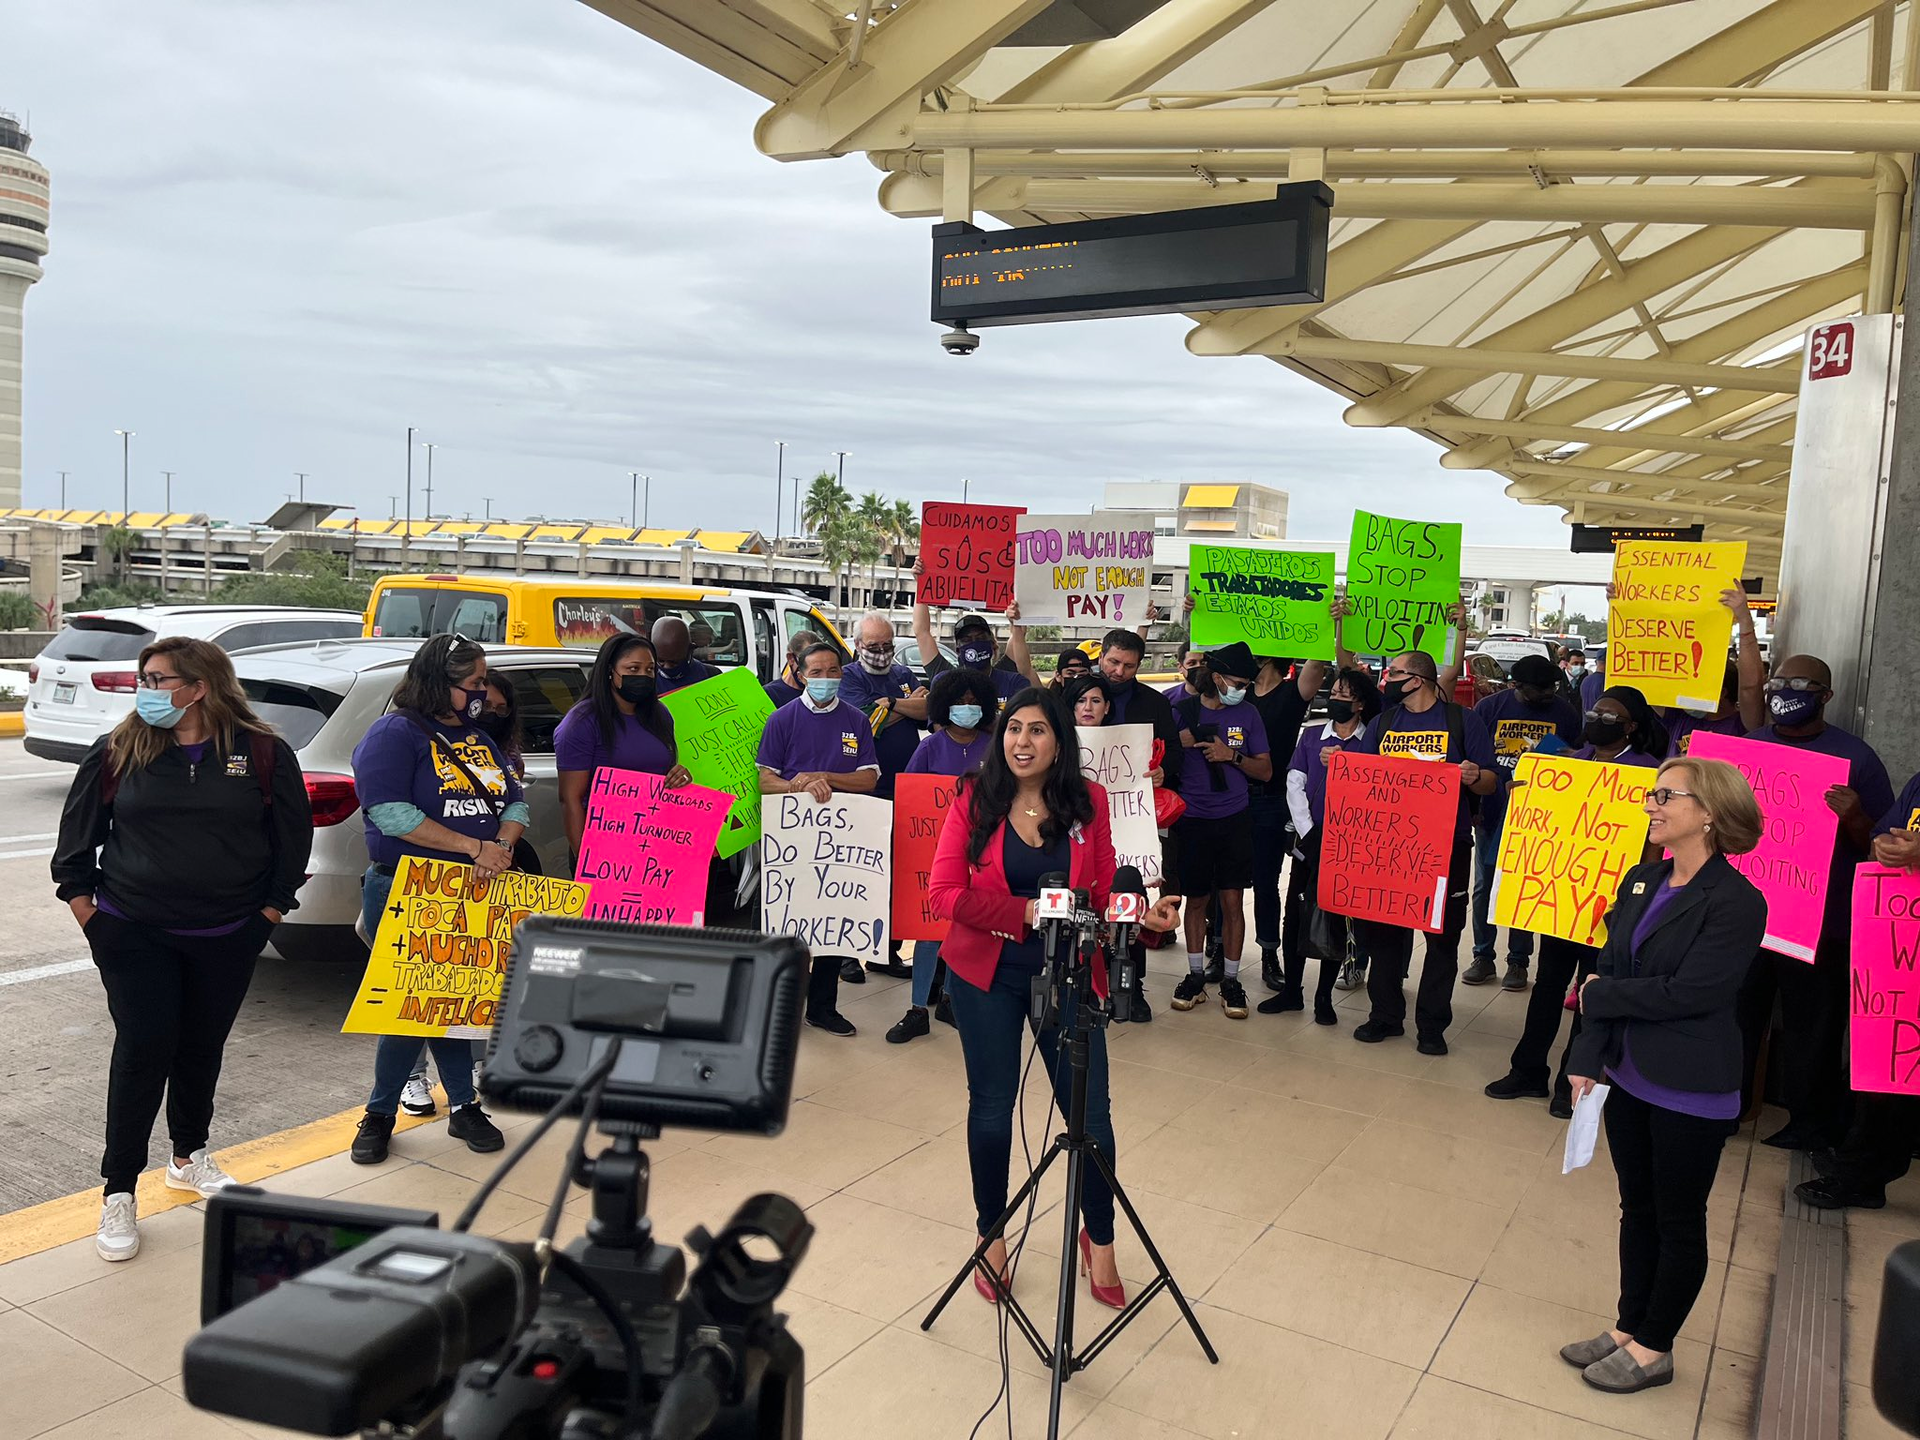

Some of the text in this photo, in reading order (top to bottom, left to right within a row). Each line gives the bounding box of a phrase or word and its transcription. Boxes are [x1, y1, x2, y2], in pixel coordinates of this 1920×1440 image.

[1811, 333, 1849, 372] 34
[924, 506, 1010, 532] CUIDAMOS
[1015, 528, 1154, 565] TOO MUCH WORK
[1366, 515, 1444, 562] BAGS,
[1616, 541, 1717, 570] ESSENTIAL
[937, 548, 992, 574] SUS
[1053, 565, 1144, 591] NOT ENOUGH
[1206, 548, 1320, 579] PASAJEROS
[1357, 552, 1427, 592] STOP
[1200, 572, 1328, 602] TRABAJADORES
[1615, 570, 1700, 602] WORKERS
[558, 601, 601, 629] Charley's
[1067, 594, 1124, 621] PAY!
[1204, 593, 1287, 620] ESTAMOS
[1612, 606, 1695, 639] DESERVE
[1240, 617, 1319, 643] UNIDOS
[1366, 619, 1425, 652] US!
[1613, 641, 1703, 679] BETTER!
[694, 686, 736, 716] DON'T
[684, 727, 723, 760] JUST
[723, 714, 758, 740] CALL
[1382, 733, 1445, 746] AIRPORT
[1498, 731, 1545, 741] WORKER
[1499, 722, 1553, 734] AIRPORT
[725, 739, 761, 774] HERO
[1079, 744, 1136, 785] BAGS,
[1381, 743, 1443, 754] WORKERS
[1495, 755, 1519, 769] RIS
[594, 769, 713, 812] HIGH WORKLOADS
[1332, 754, 1448, 795] PASSENGERS
[1522, 755, 1648, 804] TOO MUCH
[1366, 784, 1400, 804] AND
[587, 806, 692, 846] HIGH TURNOVER
[780, 795, 854, 832] BAGS,
[909, 816, 938, 839] JUST
[1328, 796, 1420, 838] WORKERS
[1509, 788, 1629, 845] WORK, NOT
[580, 848, 674, 889] LOW PAY
[764, 831, 885, 873] DO BETTER
[1336, 834, 1433, 873] DESERVE
[1502, 831, 1627, 896] ENOUGH
[402, 858, 586, 915] MUCHO TRABAJO
[765, 864, 868, 905] BY YOUR
[1333, 873, 1430, 923] BETTER!
[407, 896, 468, 934] POCA
[1116, 893, 1138, 922] 2
[1512, 874, 1608, 945] PAY!
[764, 904, 884, 956] WORKERS!
[407, 930, 494, 968] MUCHO
[393, 961, 506, 997] TRABAJADO
[1852, 967, 1906, 1016] NOT
[397, 988, 501, 1027] INFELICE
